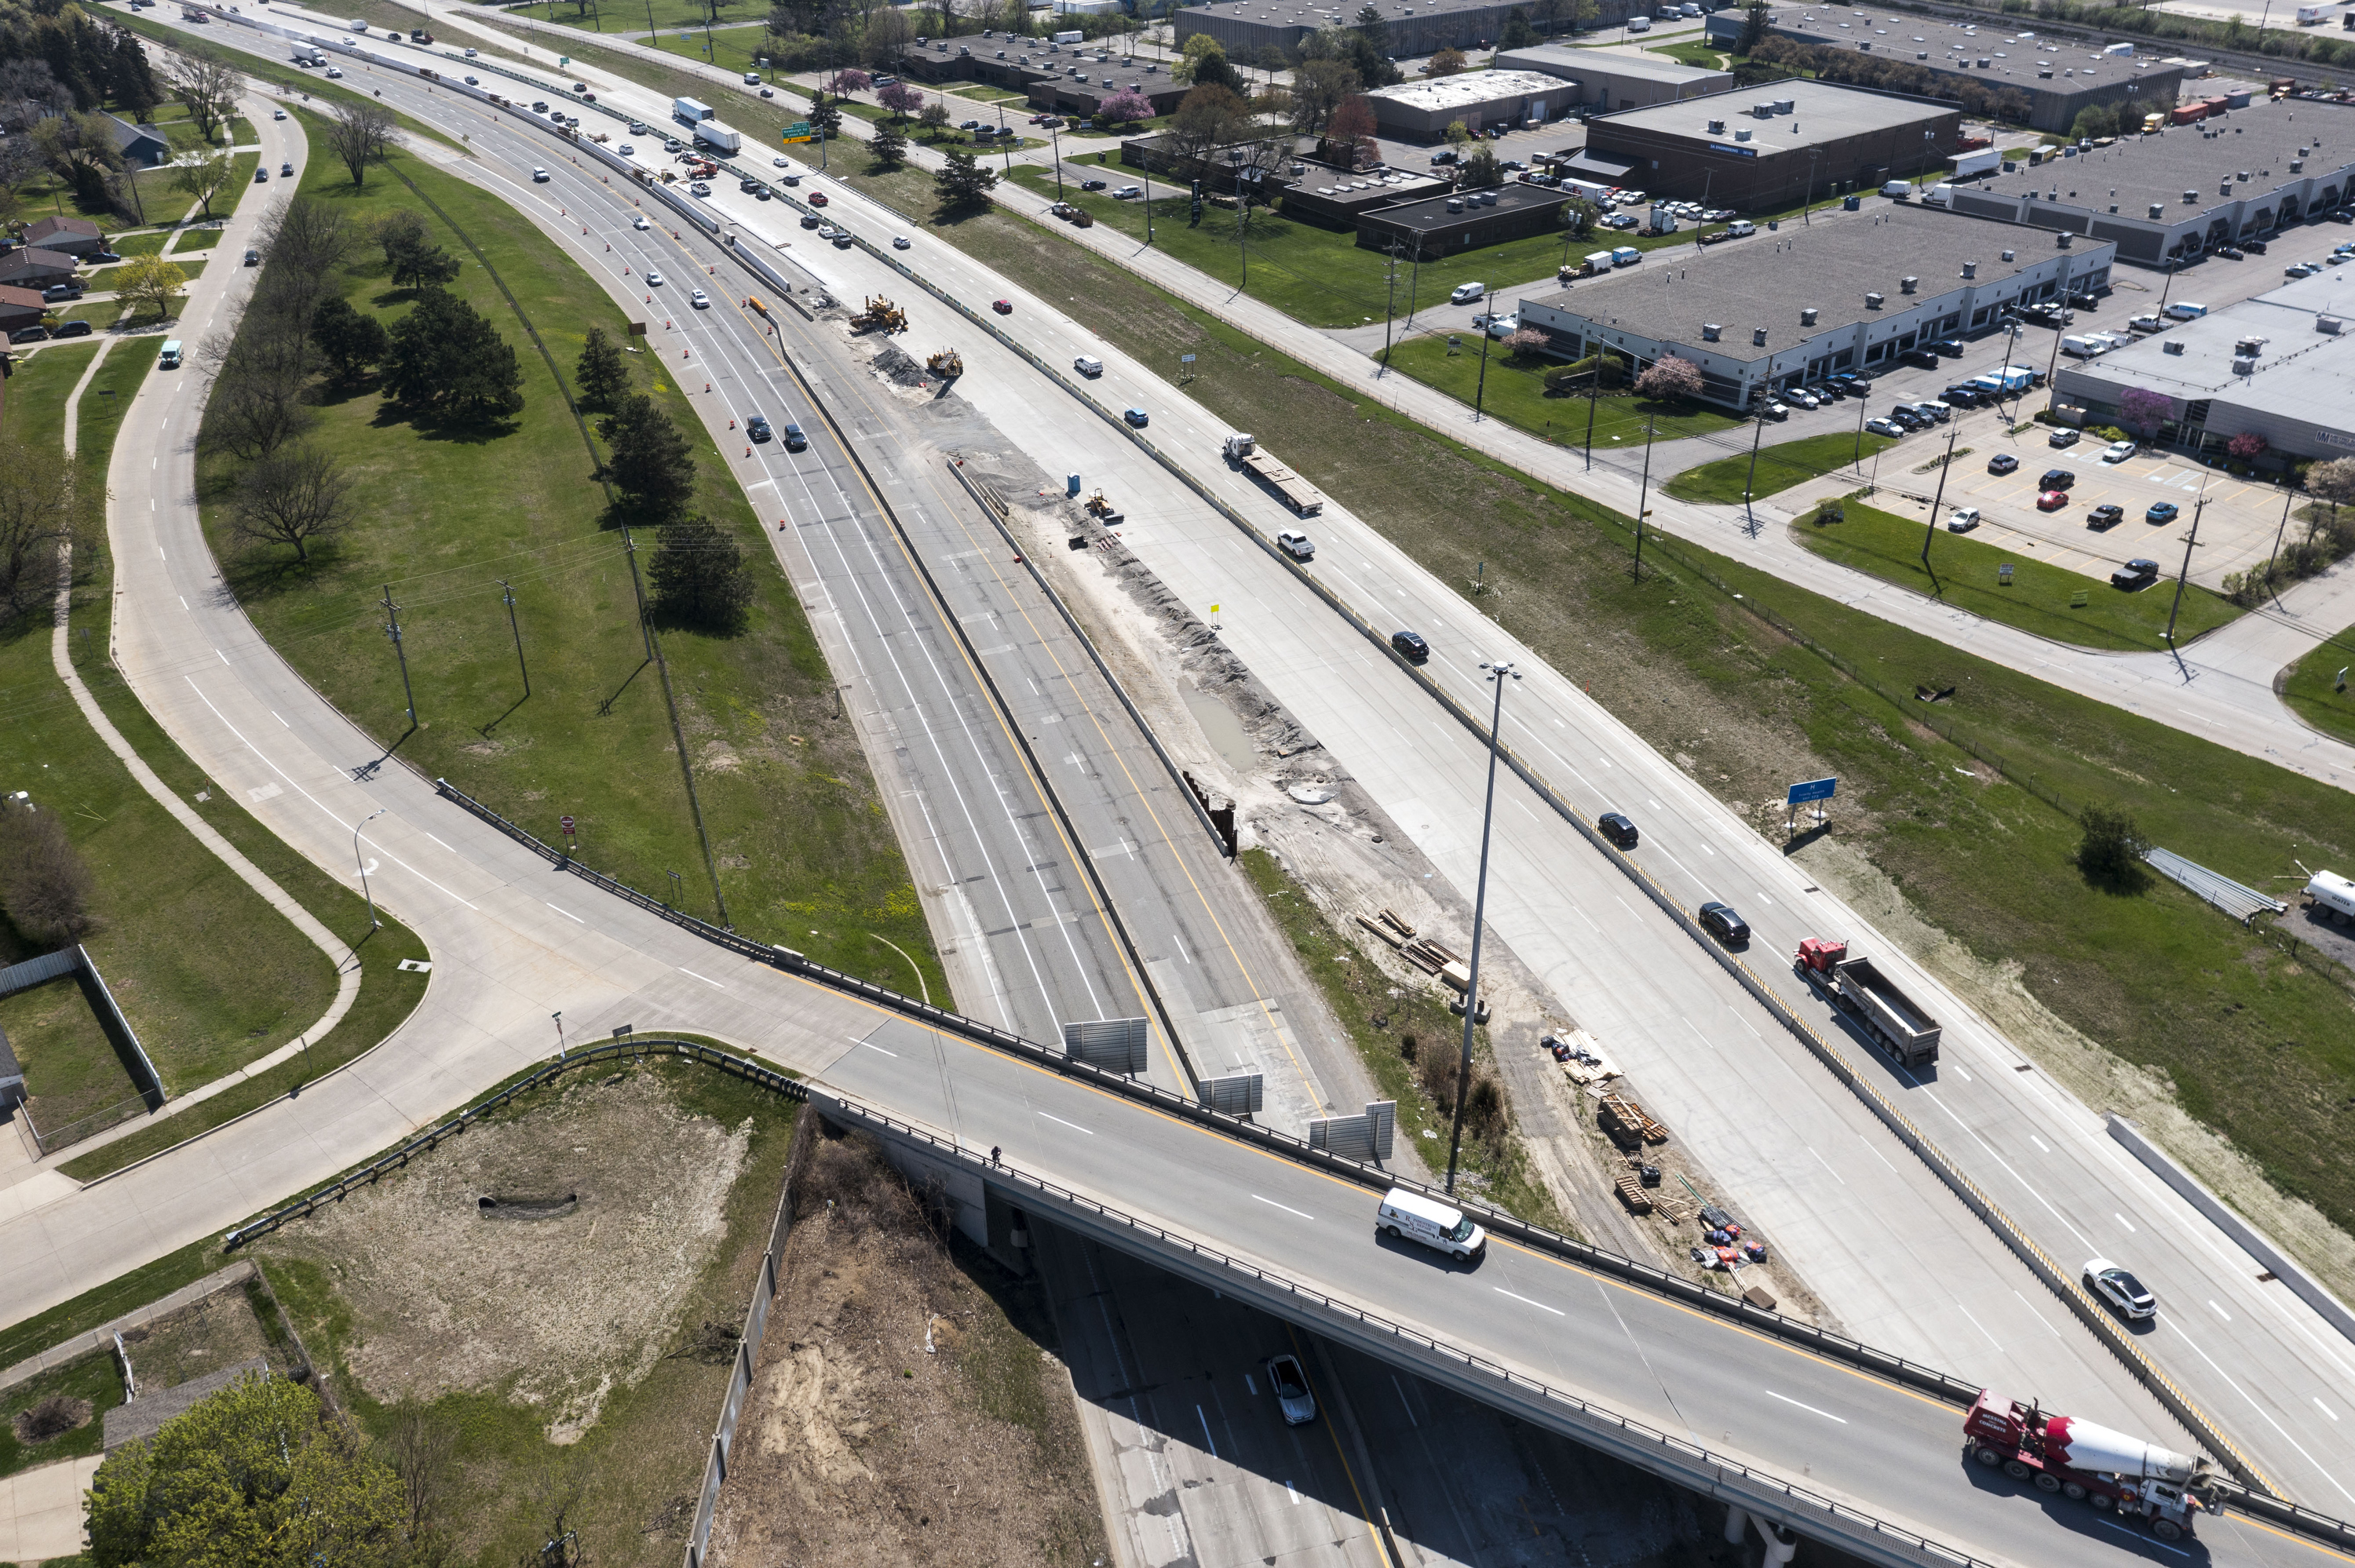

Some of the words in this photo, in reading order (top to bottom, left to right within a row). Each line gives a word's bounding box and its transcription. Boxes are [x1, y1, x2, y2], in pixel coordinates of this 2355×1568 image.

[1563, 183, 1583, 195] FedEx
[2331, 895, 2351, 907] WATER
[1413, 1218, 1437, 1230] INDUSTRIAL
[1417, 1223, 1432, 1231] REPAIR
[1982, 1413, 2007, 1426] MESSINA
[1978, 1420, 2006, 1433] CONCRETE
